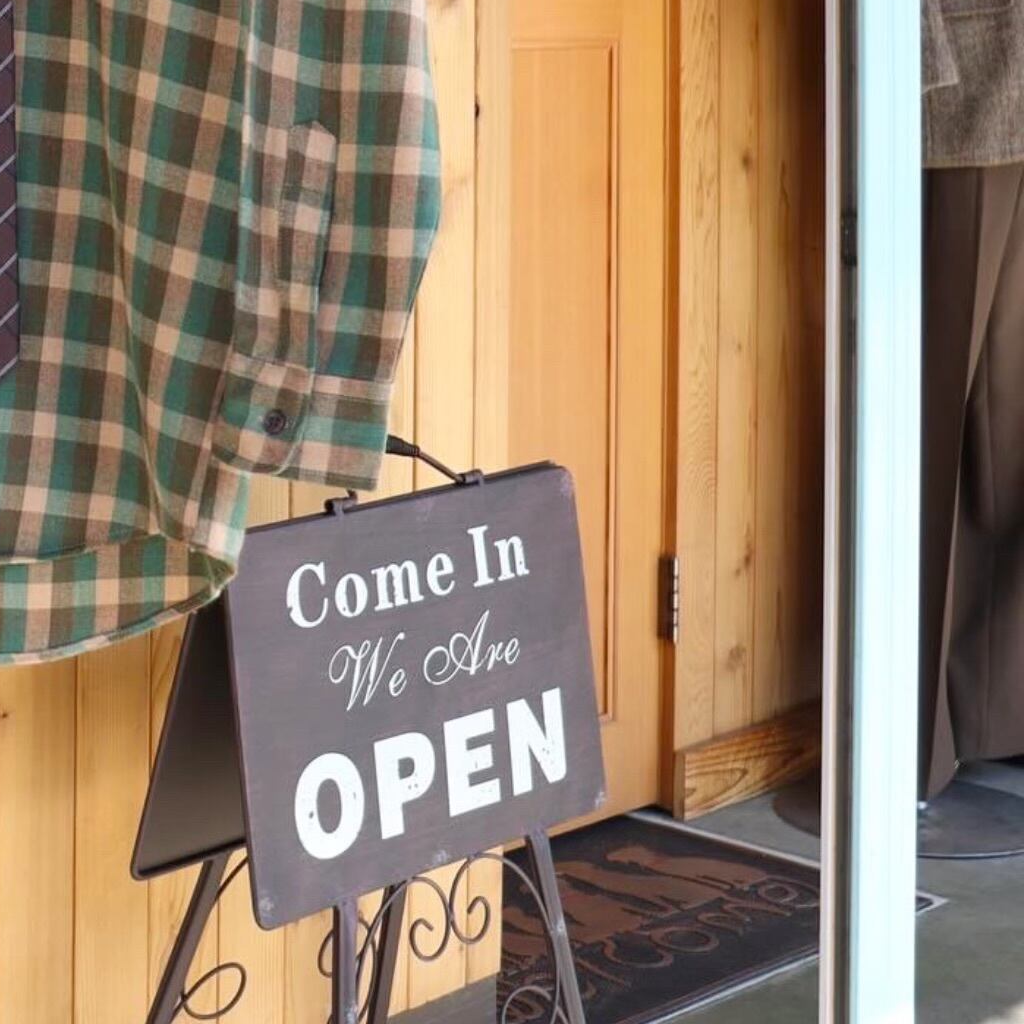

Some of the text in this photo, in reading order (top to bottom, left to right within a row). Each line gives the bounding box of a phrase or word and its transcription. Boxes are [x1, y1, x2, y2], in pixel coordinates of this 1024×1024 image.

[286, 525, 530, 628] Come In
[328, 609, 521, 712] We Are
[294, 687, 568, 860] OPEN
